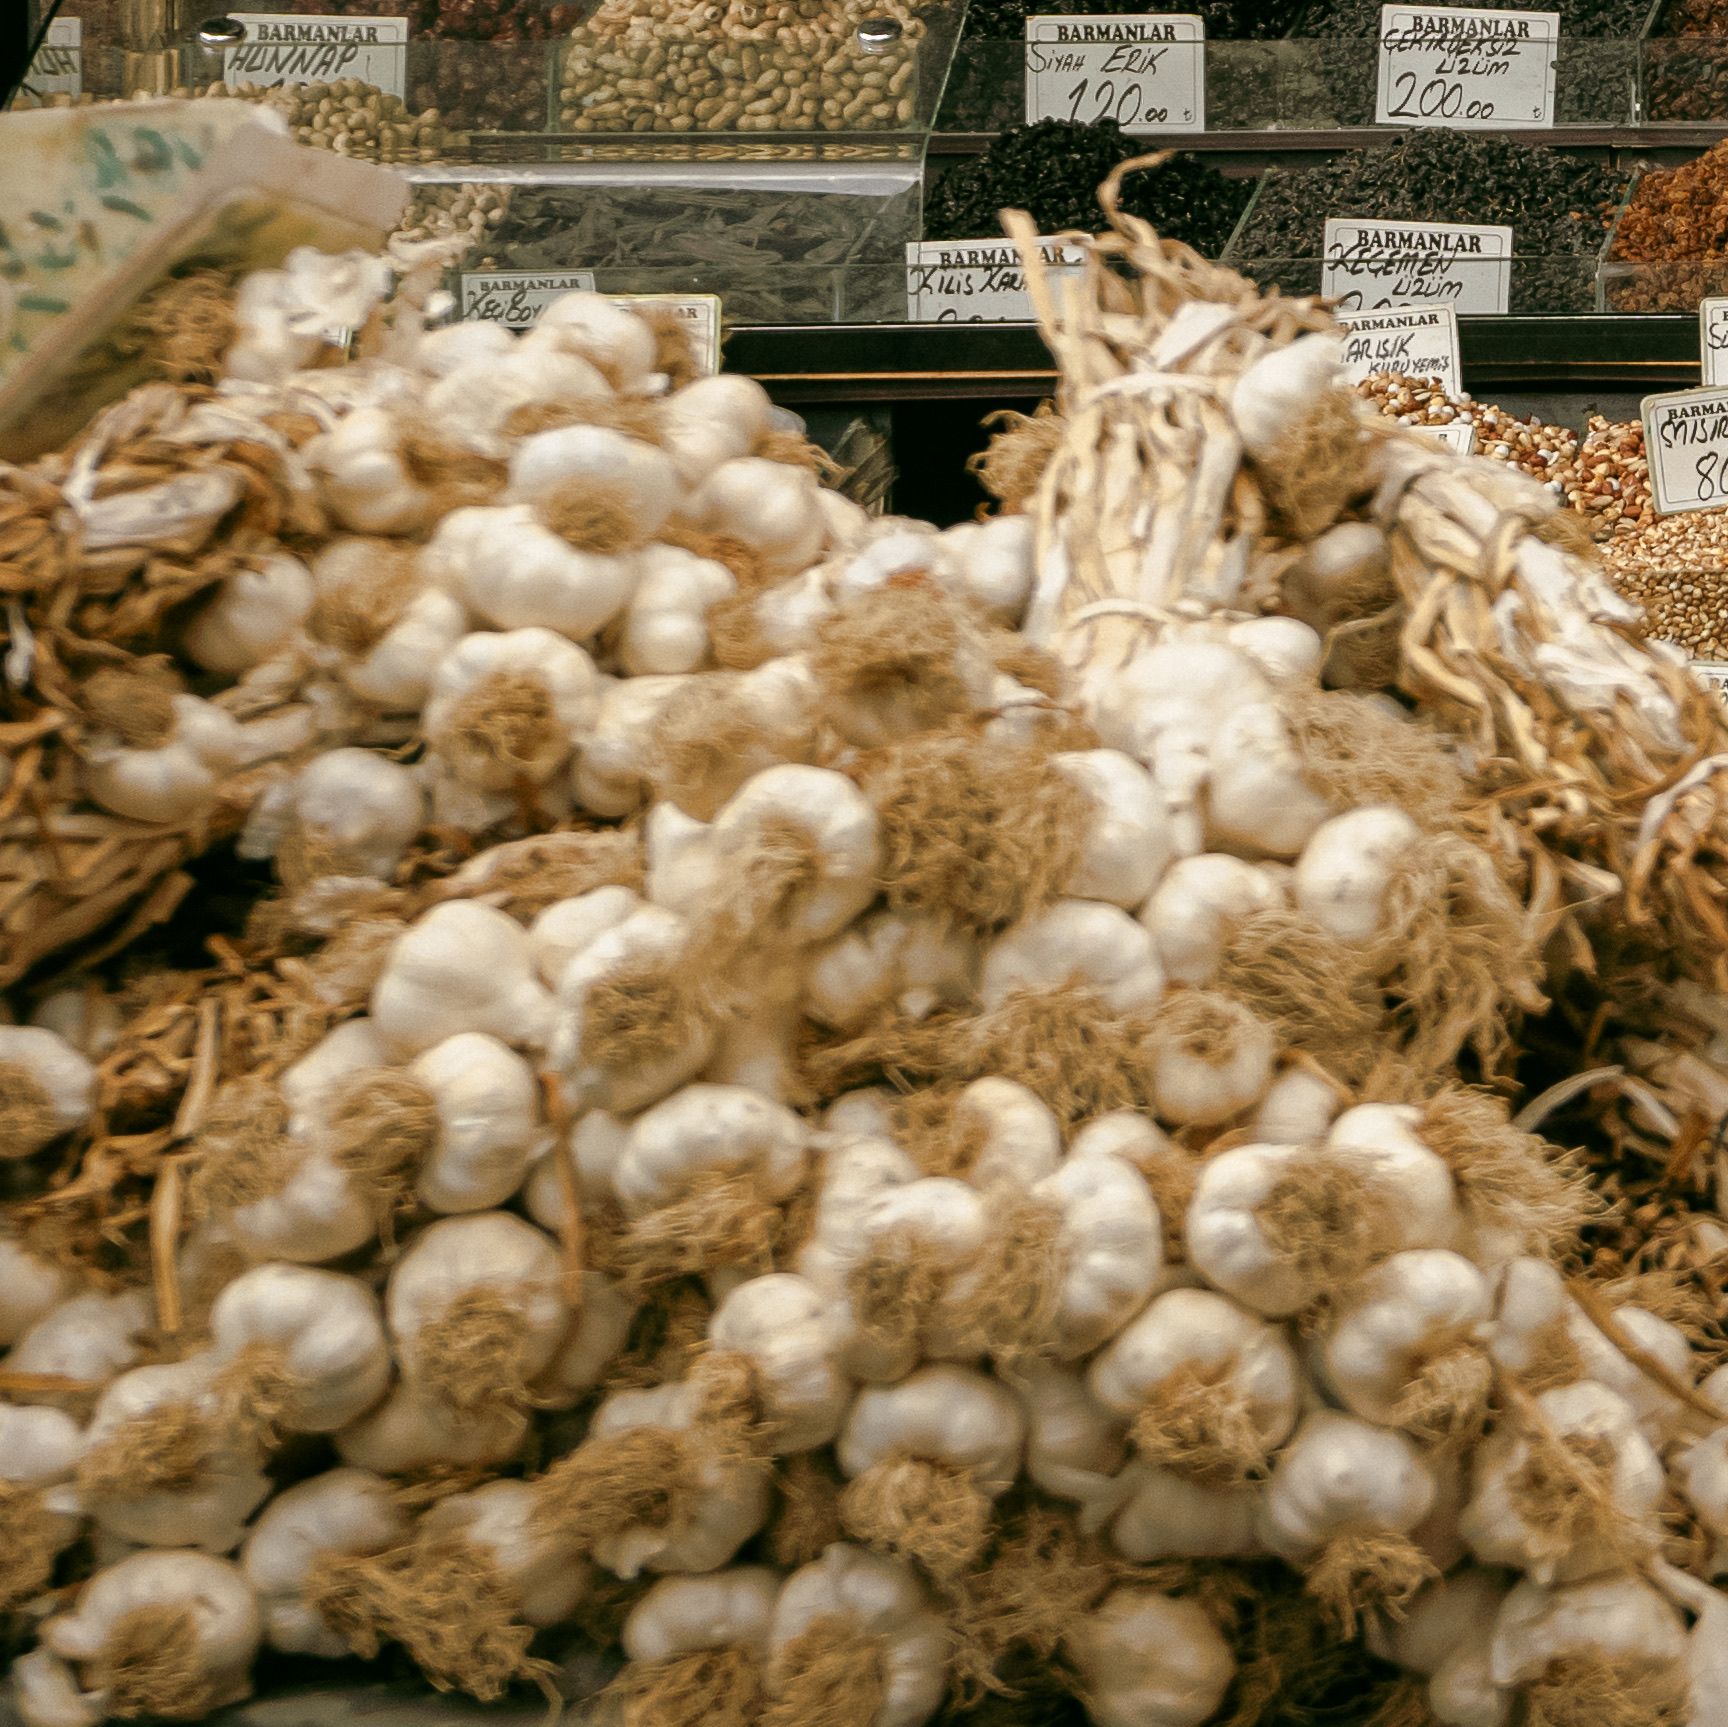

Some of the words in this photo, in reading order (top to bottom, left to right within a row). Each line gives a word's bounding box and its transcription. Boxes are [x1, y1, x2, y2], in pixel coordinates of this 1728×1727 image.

[258, 24, 378, 43] BARMANLAR
[1057, 24, 1176, 41] BARMANLAR
[1412, 16, 1529, 38] BARMANLAR
[1388, 71, 1494, 119] 200.00
[1357, 230, 1482, 253] BARMANLAR
[940, 246, 1066, 268] BARMANAR
[480, 278, 580, 291] BARMANLAR
[1341, 333, 1415, 363] ARIŞIK
